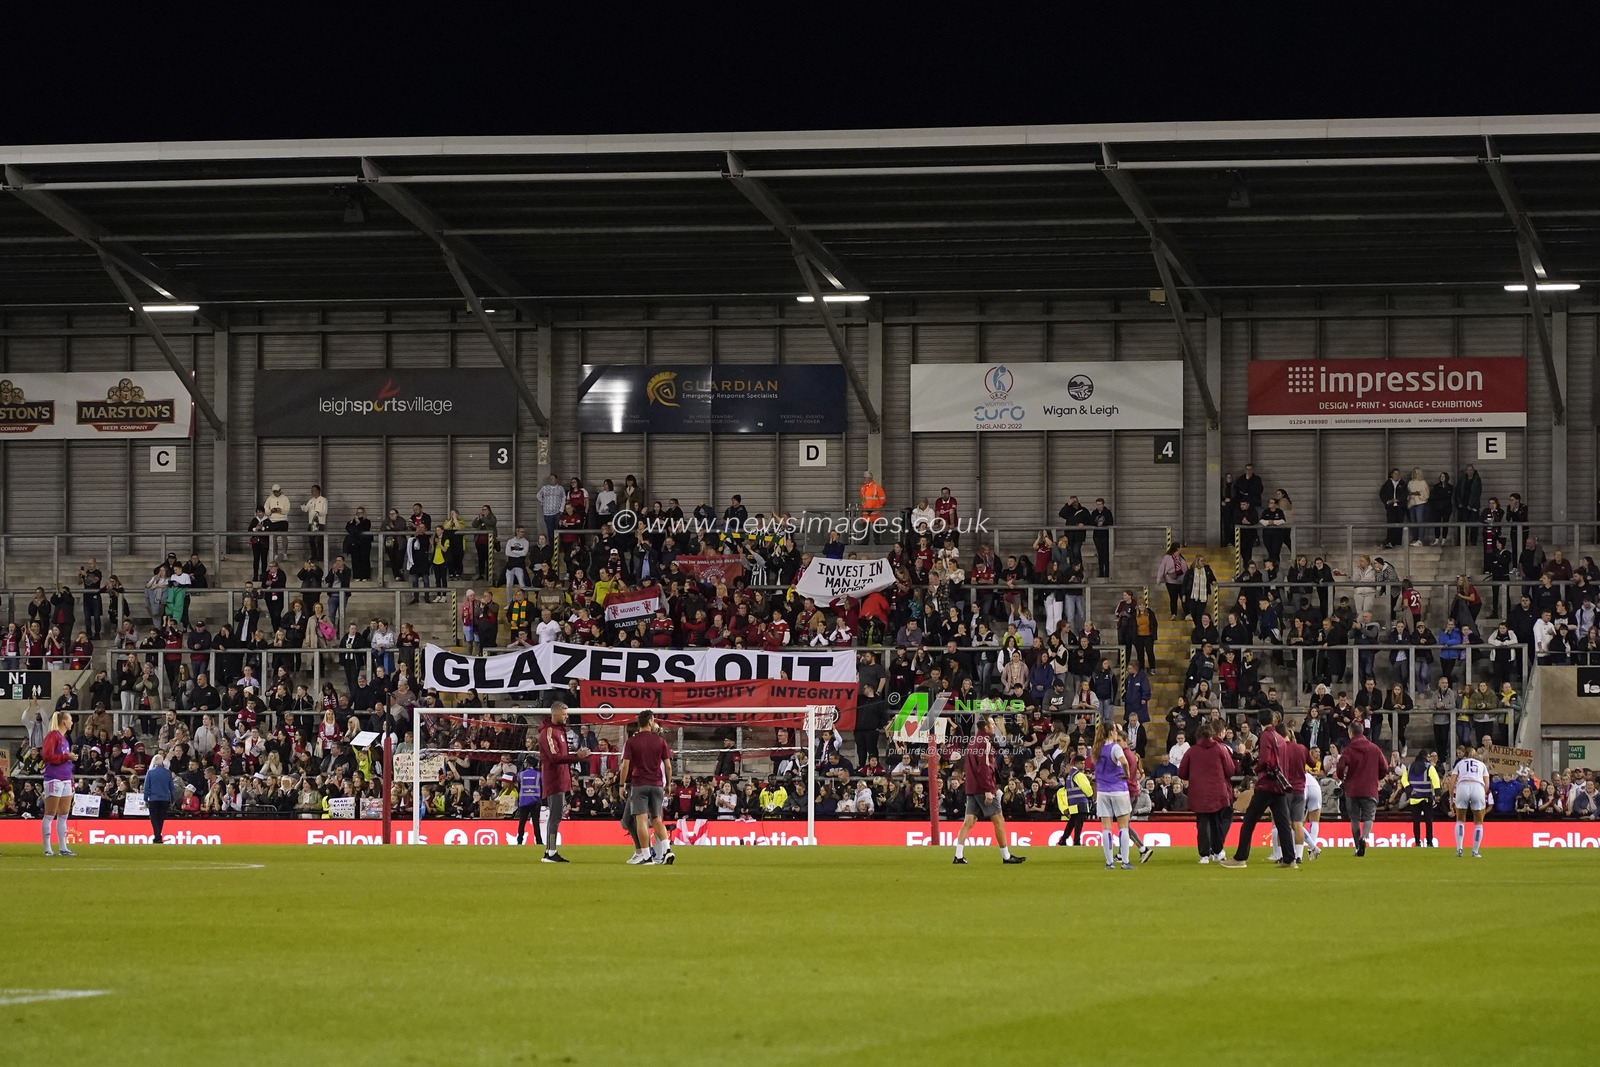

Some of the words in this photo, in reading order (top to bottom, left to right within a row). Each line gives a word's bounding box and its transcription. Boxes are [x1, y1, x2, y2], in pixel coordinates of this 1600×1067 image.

[682, 380, 778, 391] GUARDIAN
[1320, 365, 1482, 398] impression
[82, 404, 171, 419] MARSTON'S
[1043, 406, 1077, 418] Wigan
[1079, 406, 1088, 415] &
[1090, 404, 1119, 417] Leigh
[1432, 400, 1482, 408] EXHIBITIONS
[807, 446, 819, 460] D
[1162, 442, 1174, 458] 4
[1486, 438, 1497, 453] E
[156, 451, 170, 466] C
[497, 448, 508, 464] 3
[817, 562, 865, 577] INVEST
[869, 560, 883, 577] IN
[825, 577, 850, 588] MAN
[433, 645, 696, 689] GLAZERS
[714, 653, 834, 682] OUT
[9, 672, 26, 684] N1
[590, 686, 659, 699] HISTORY
[687, 686, 756, 698] DIGNITY
[770, 686, 855, 700] INTEGRITY
[1464, 760, 1478, 773] 15
[89, 830, 221, 845] Founation
[1532, 832, 1600, 847] Follo
